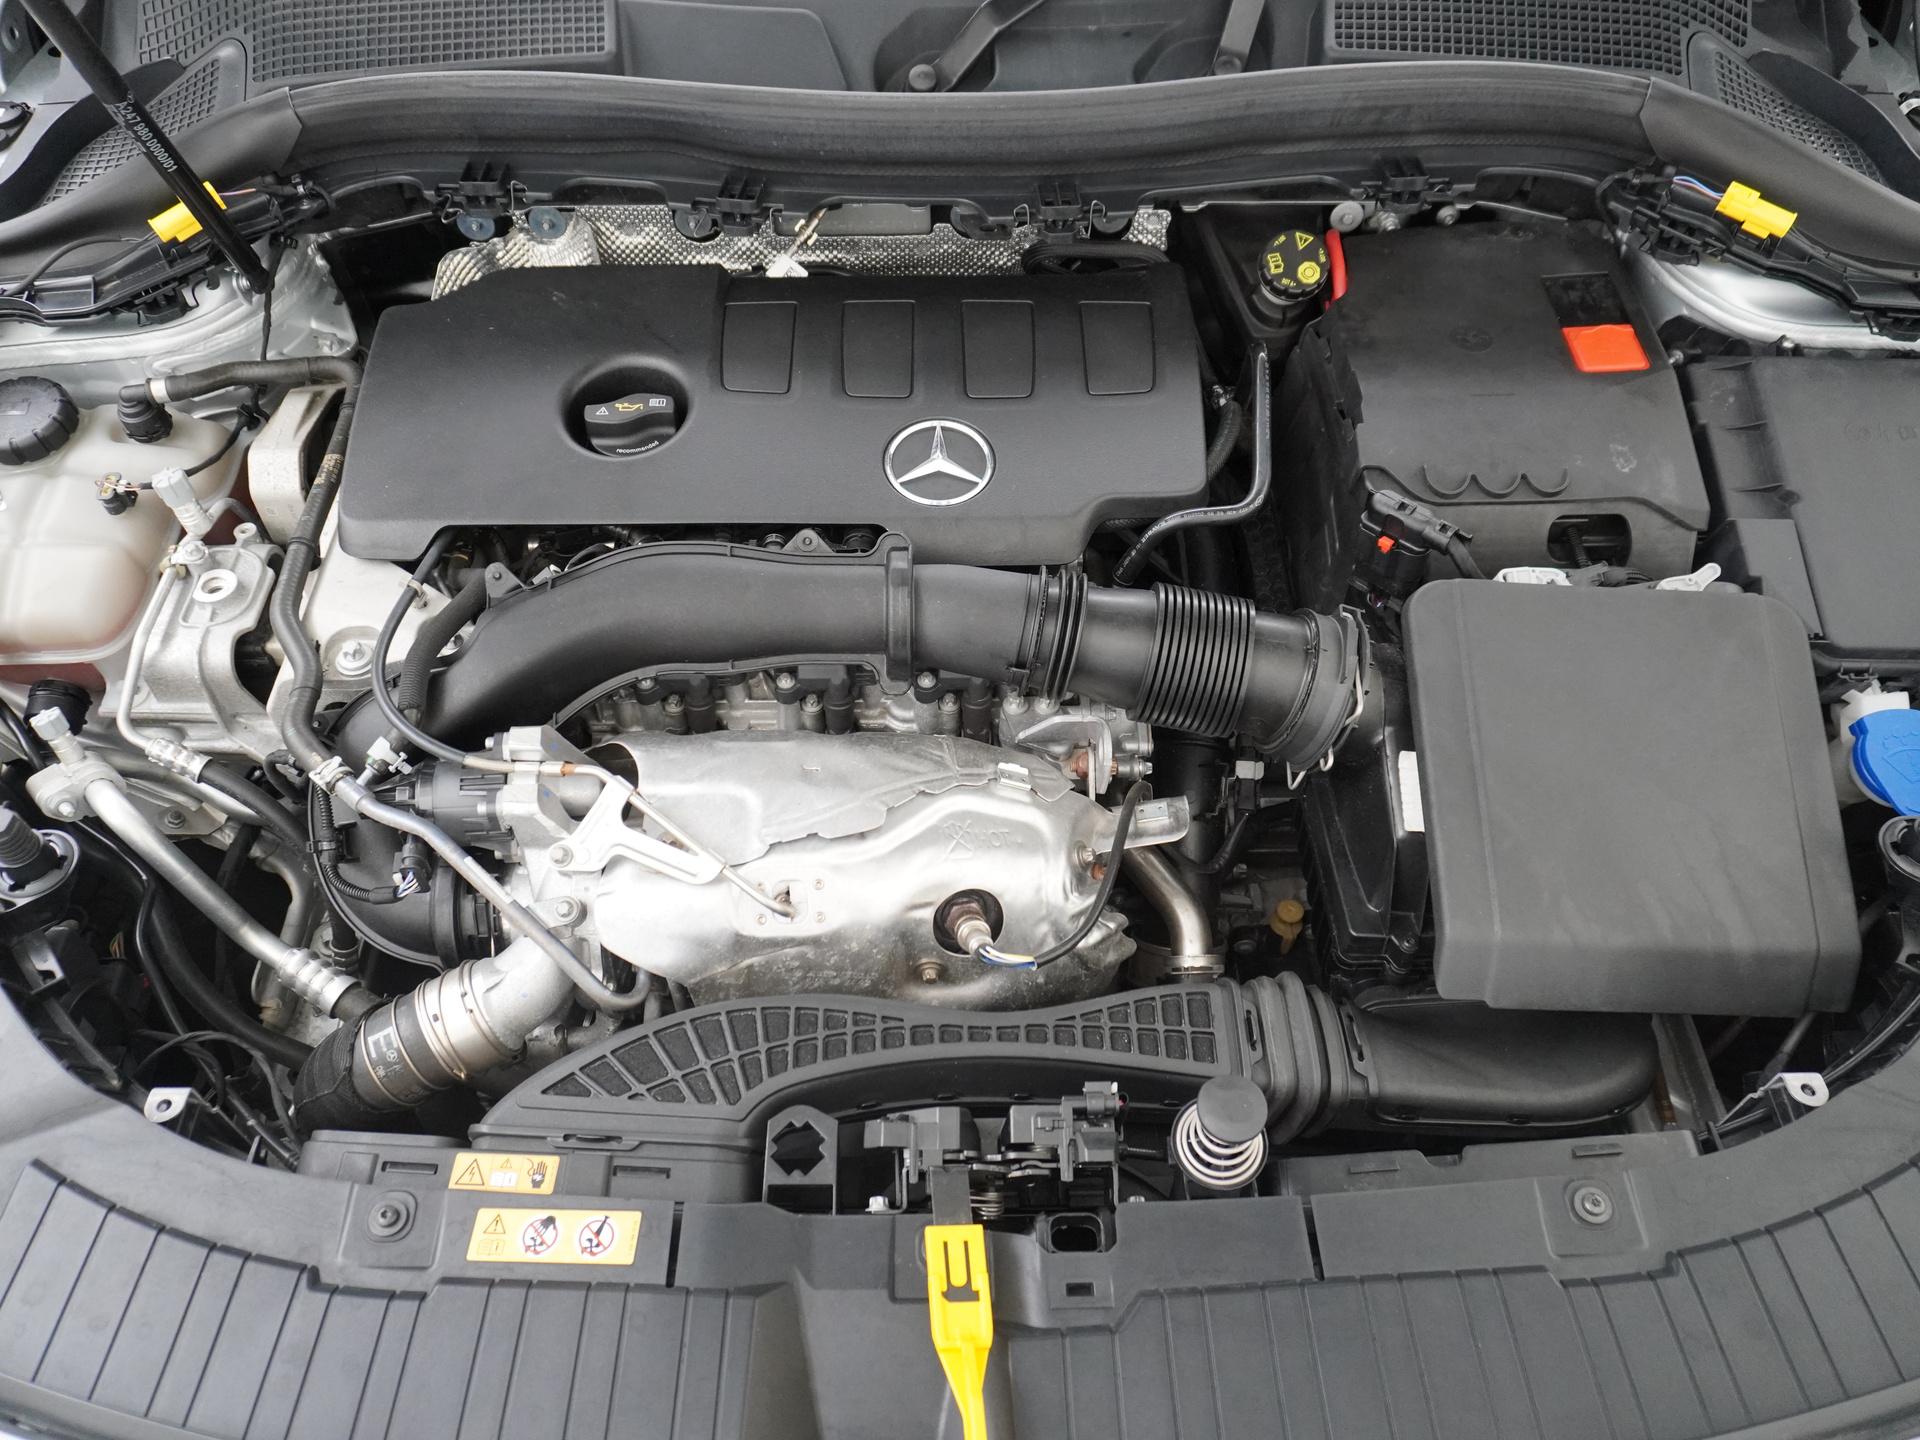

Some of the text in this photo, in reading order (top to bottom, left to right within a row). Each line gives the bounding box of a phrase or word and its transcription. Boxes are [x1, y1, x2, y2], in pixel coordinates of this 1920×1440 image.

[115, 101, 178, 172] A247 980 0000/01
